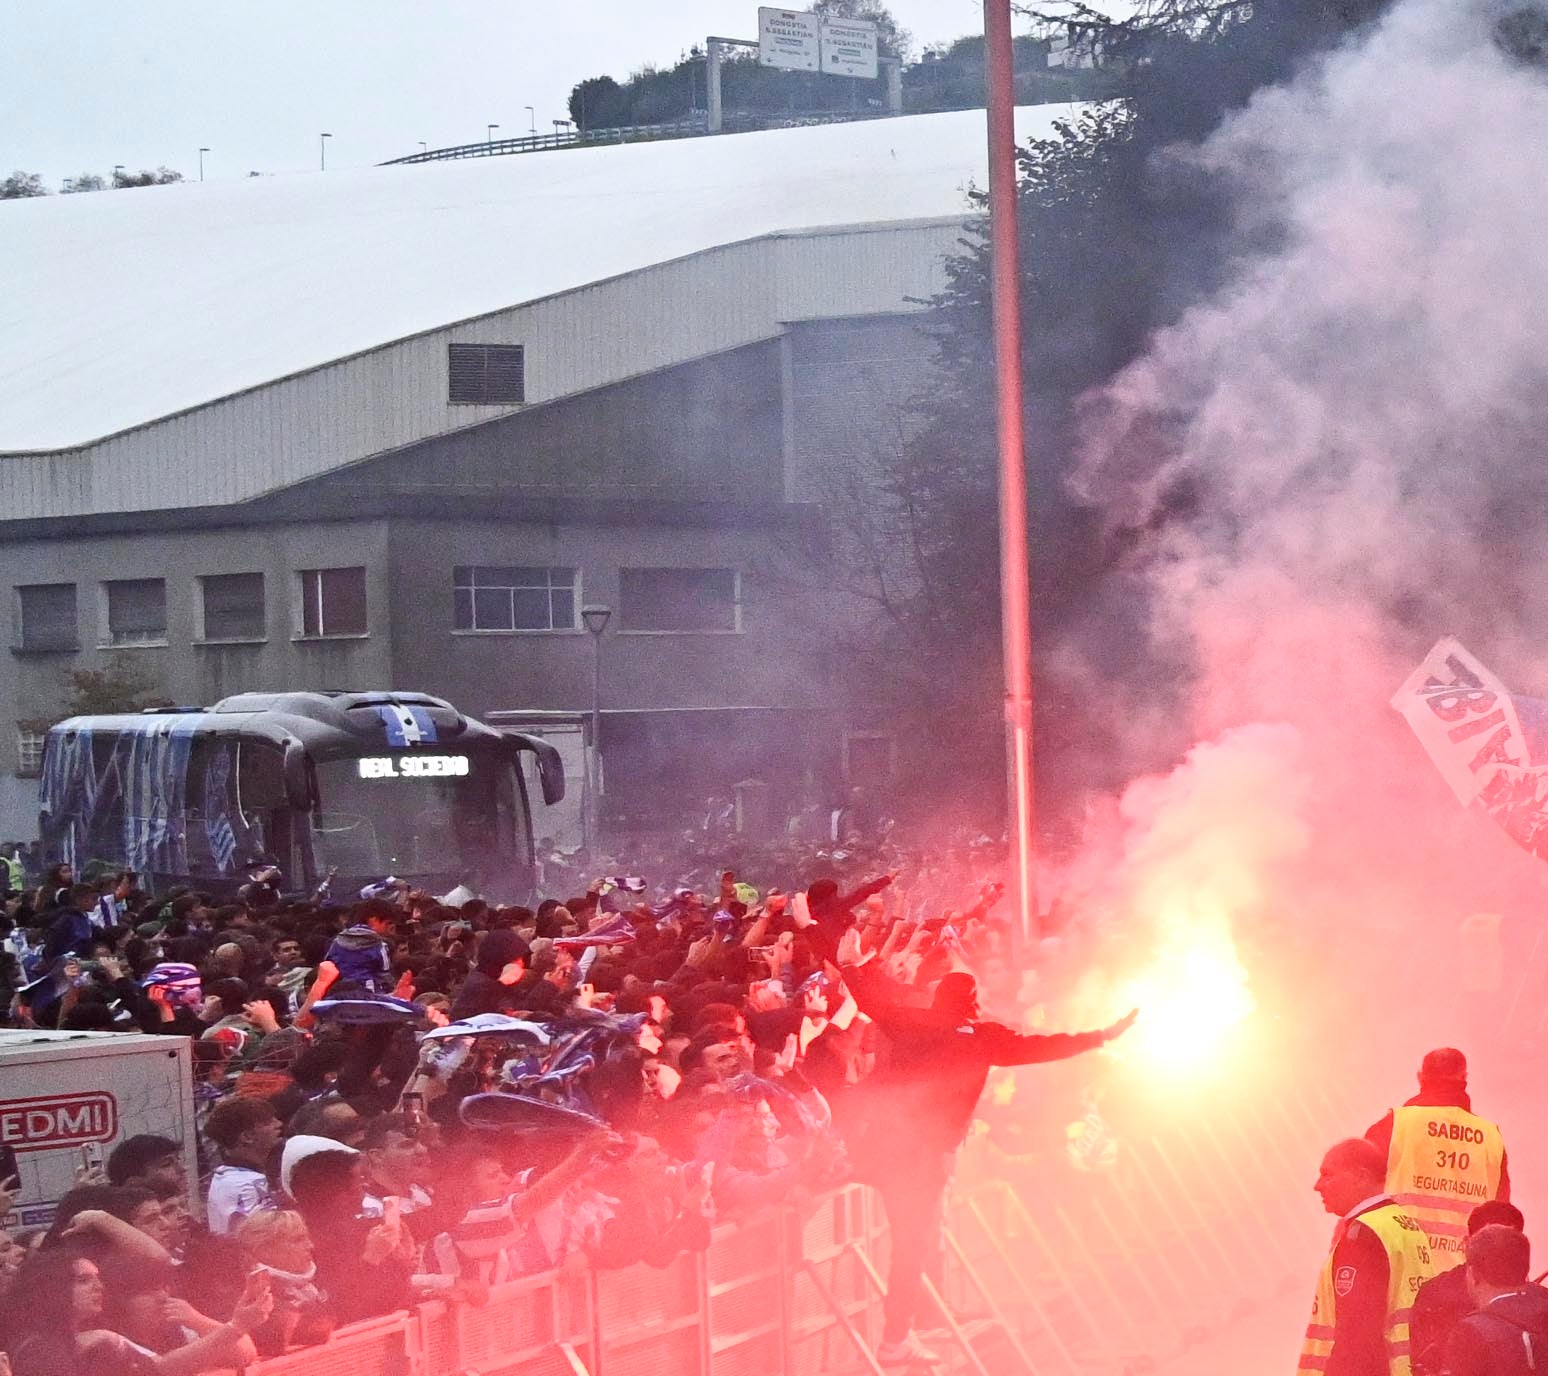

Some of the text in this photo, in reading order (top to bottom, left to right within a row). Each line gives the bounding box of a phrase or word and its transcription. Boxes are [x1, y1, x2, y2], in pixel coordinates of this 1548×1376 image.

[359, 755, 469, 779] REAL SOCIEDAD
[1, 1105, 103, 1142] EDMI
[1427, 1121, 1484, 1144] SABICO
[1436, 1150, 1470, 1170] 310
